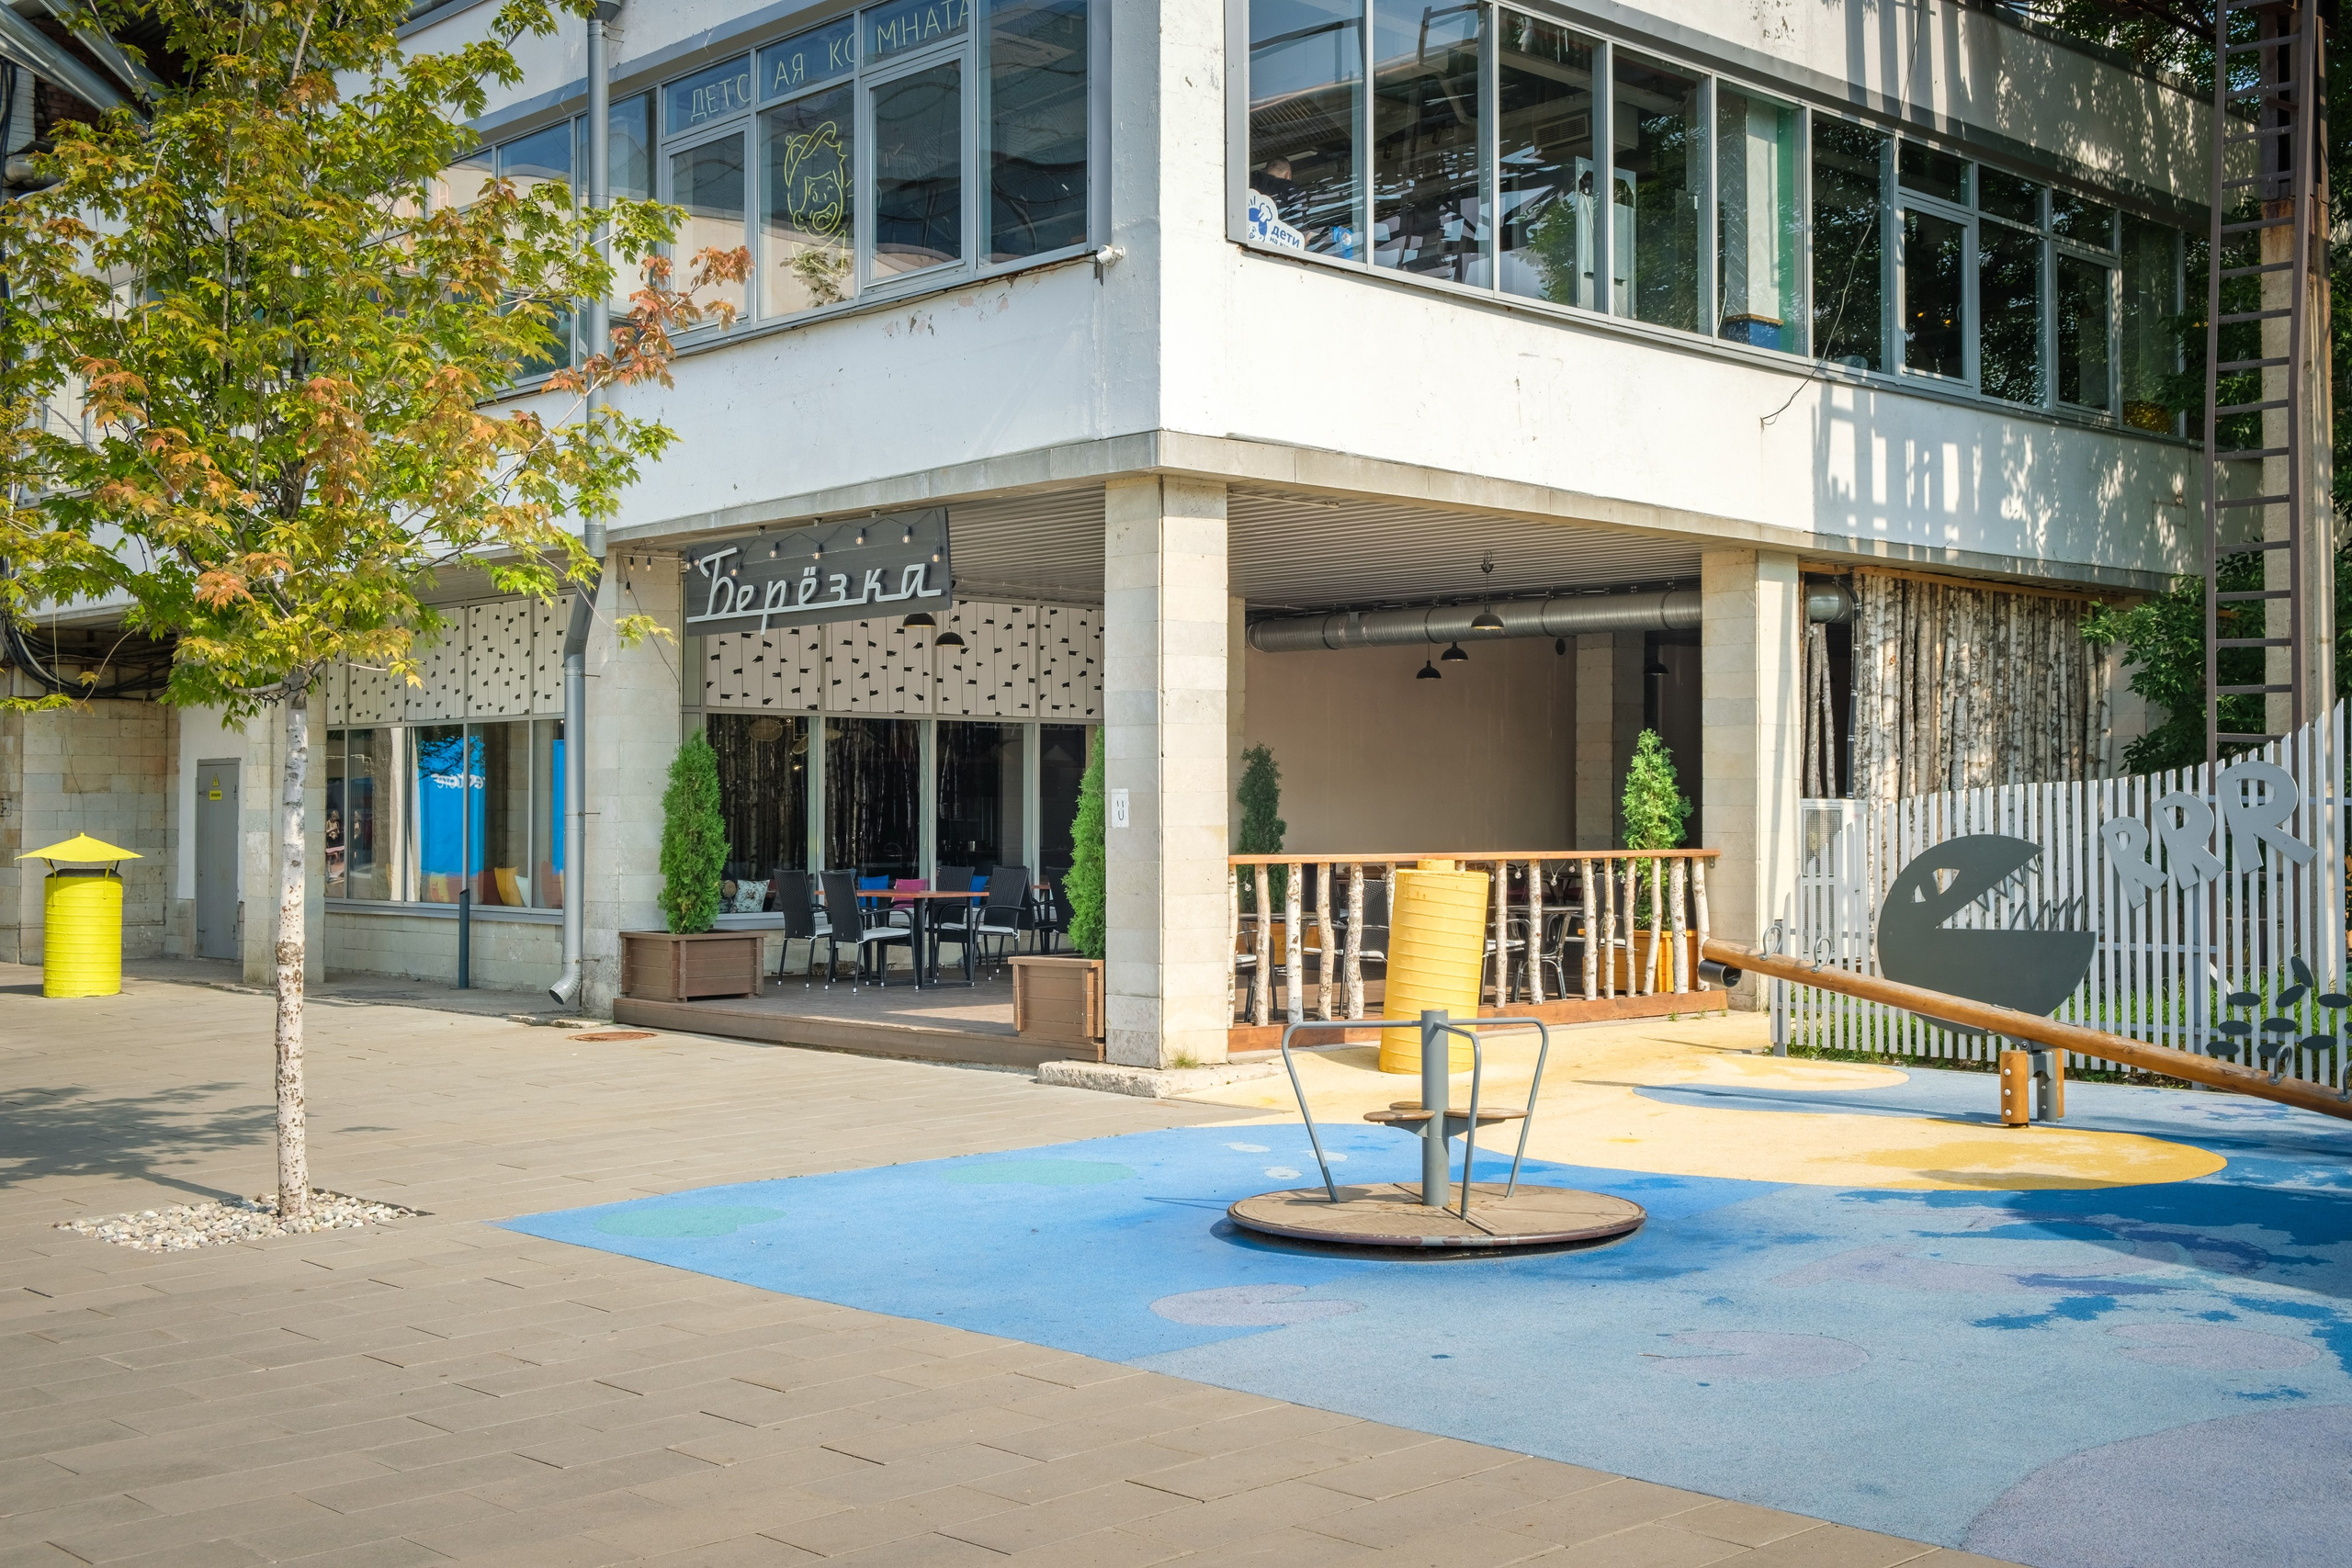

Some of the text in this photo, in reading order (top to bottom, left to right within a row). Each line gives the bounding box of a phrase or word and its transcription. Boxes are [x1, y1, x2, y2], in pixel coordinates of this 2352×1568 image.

[691, 52, 804, 122] ДЕТСАЯ
[1271, 225, 1300, 249] дети
[686, 547, 942, 636] Берёзка
